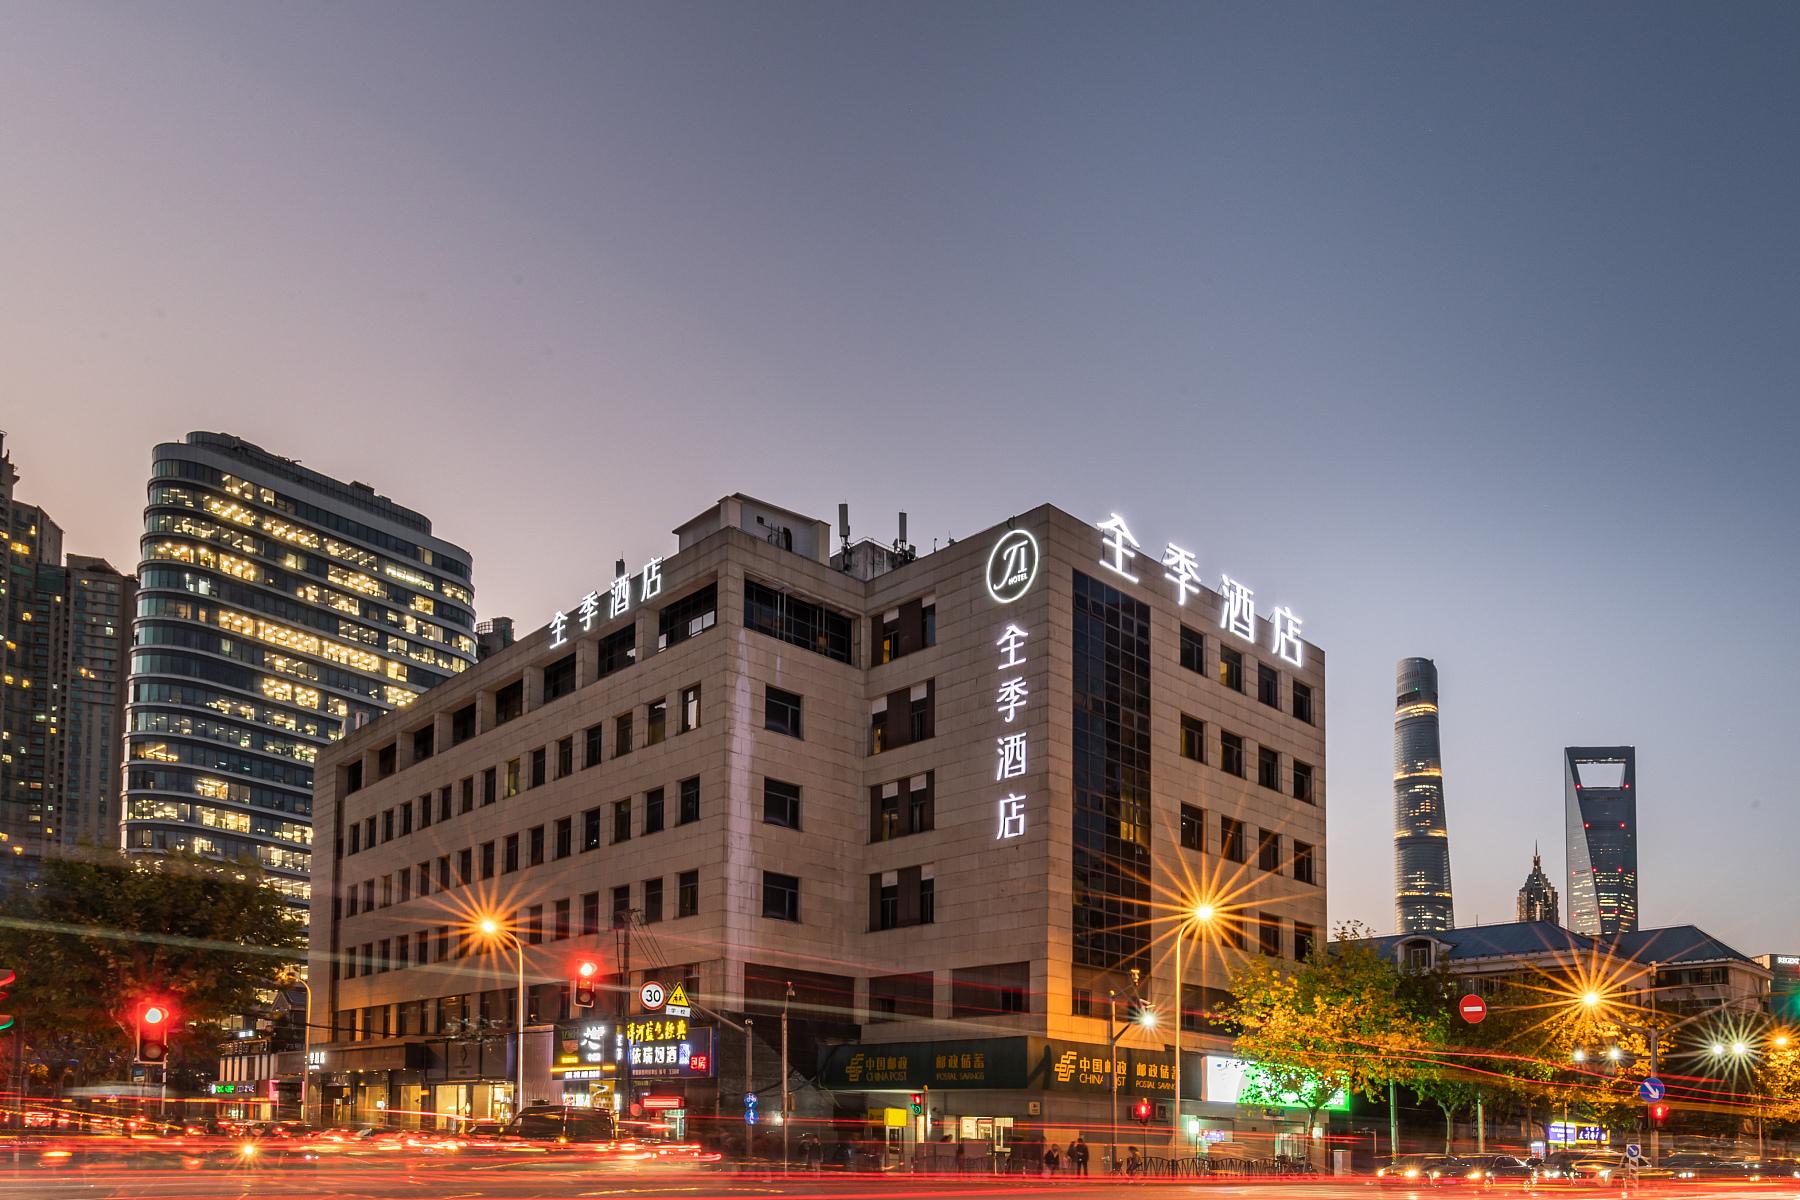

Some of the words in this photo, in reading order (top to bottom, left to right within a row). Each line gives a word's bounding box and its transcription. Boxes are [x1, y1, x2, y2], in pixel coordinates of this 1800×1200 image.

[1008, 572, 1029, 586] HOTEL
[1096, 512, 1304, 668] 全季酒店
[548, 556, 663, 650] 全季酒店
[996, 624, 1029, 840] 全季酒店
[645, 989, 661, 1003] 30
[865, 1055, 908, 1071] 中国邮政
[935, 1053, 985, 1069] 邮政储蓄
[1136, 1080, 1155, 1089] POSTAL
